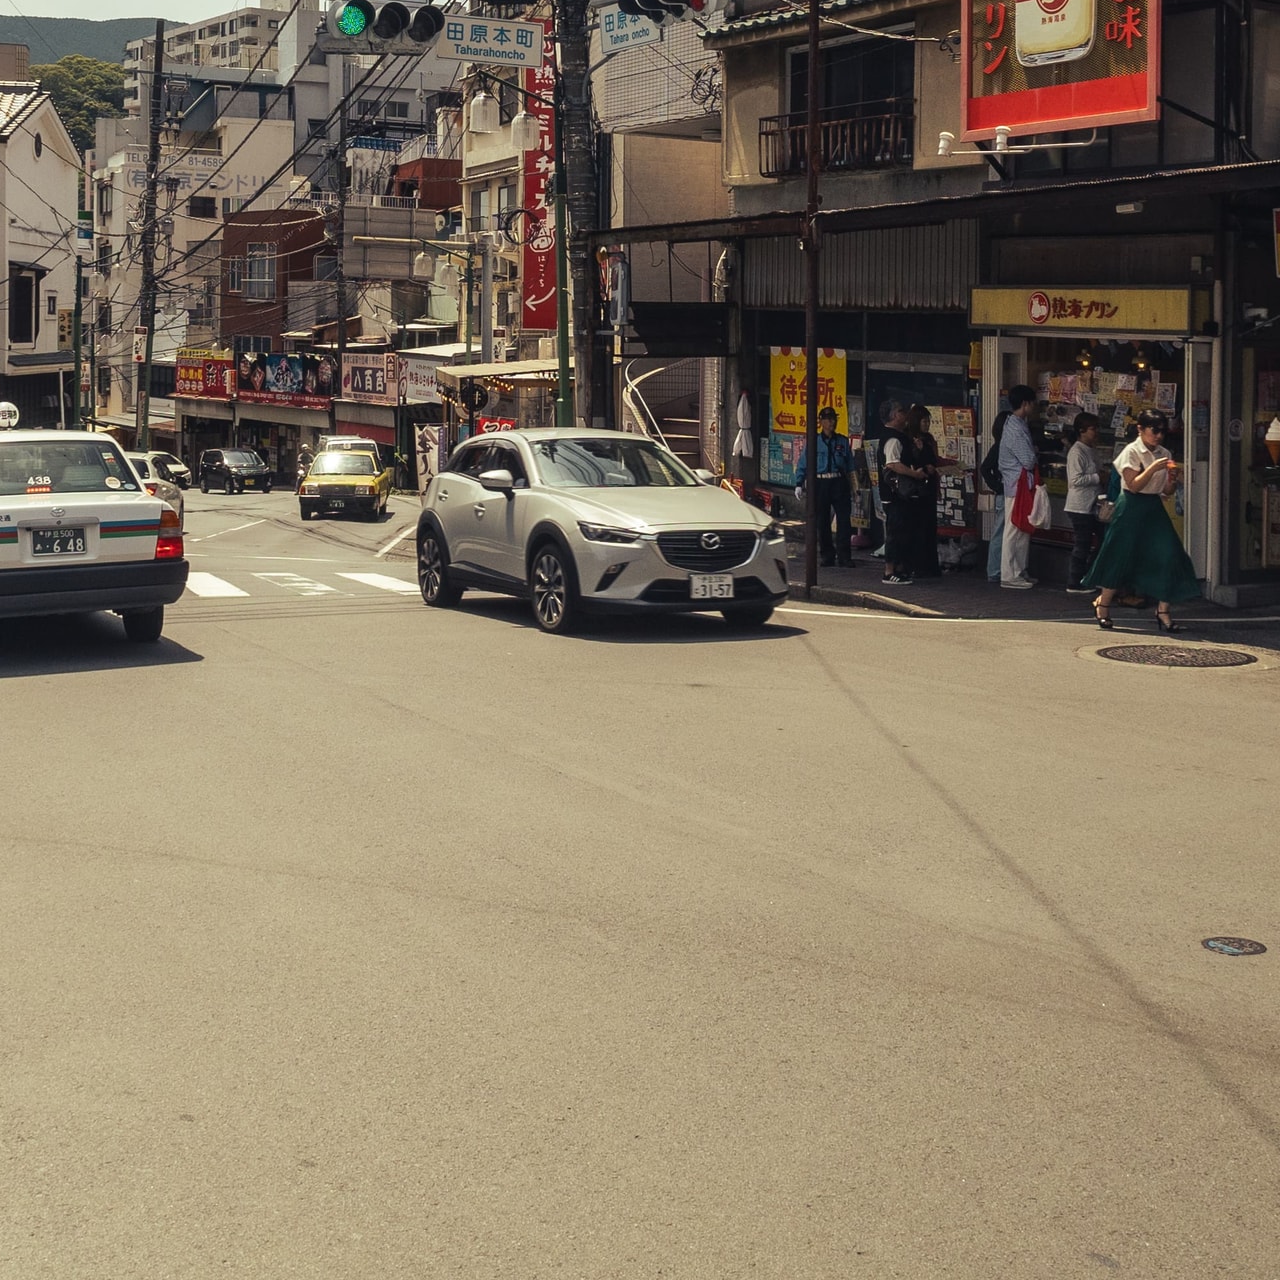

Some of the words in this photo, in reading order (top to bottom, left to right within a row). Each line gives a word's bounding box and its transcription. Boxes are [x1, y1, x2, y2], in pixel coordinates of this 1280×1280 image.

[605, 11, 640, 32] 田原本
[446, 22, 534, 49] 田原本町
[454, 43, 526, 61] Taharahoncho
[126, 169, 283, 192] (有京ランドリー
[1051, 296, 1119, 320] 熱海プリン
[27, 476, 52, 485] 438
[700, 583, 732, 597] 31-57
